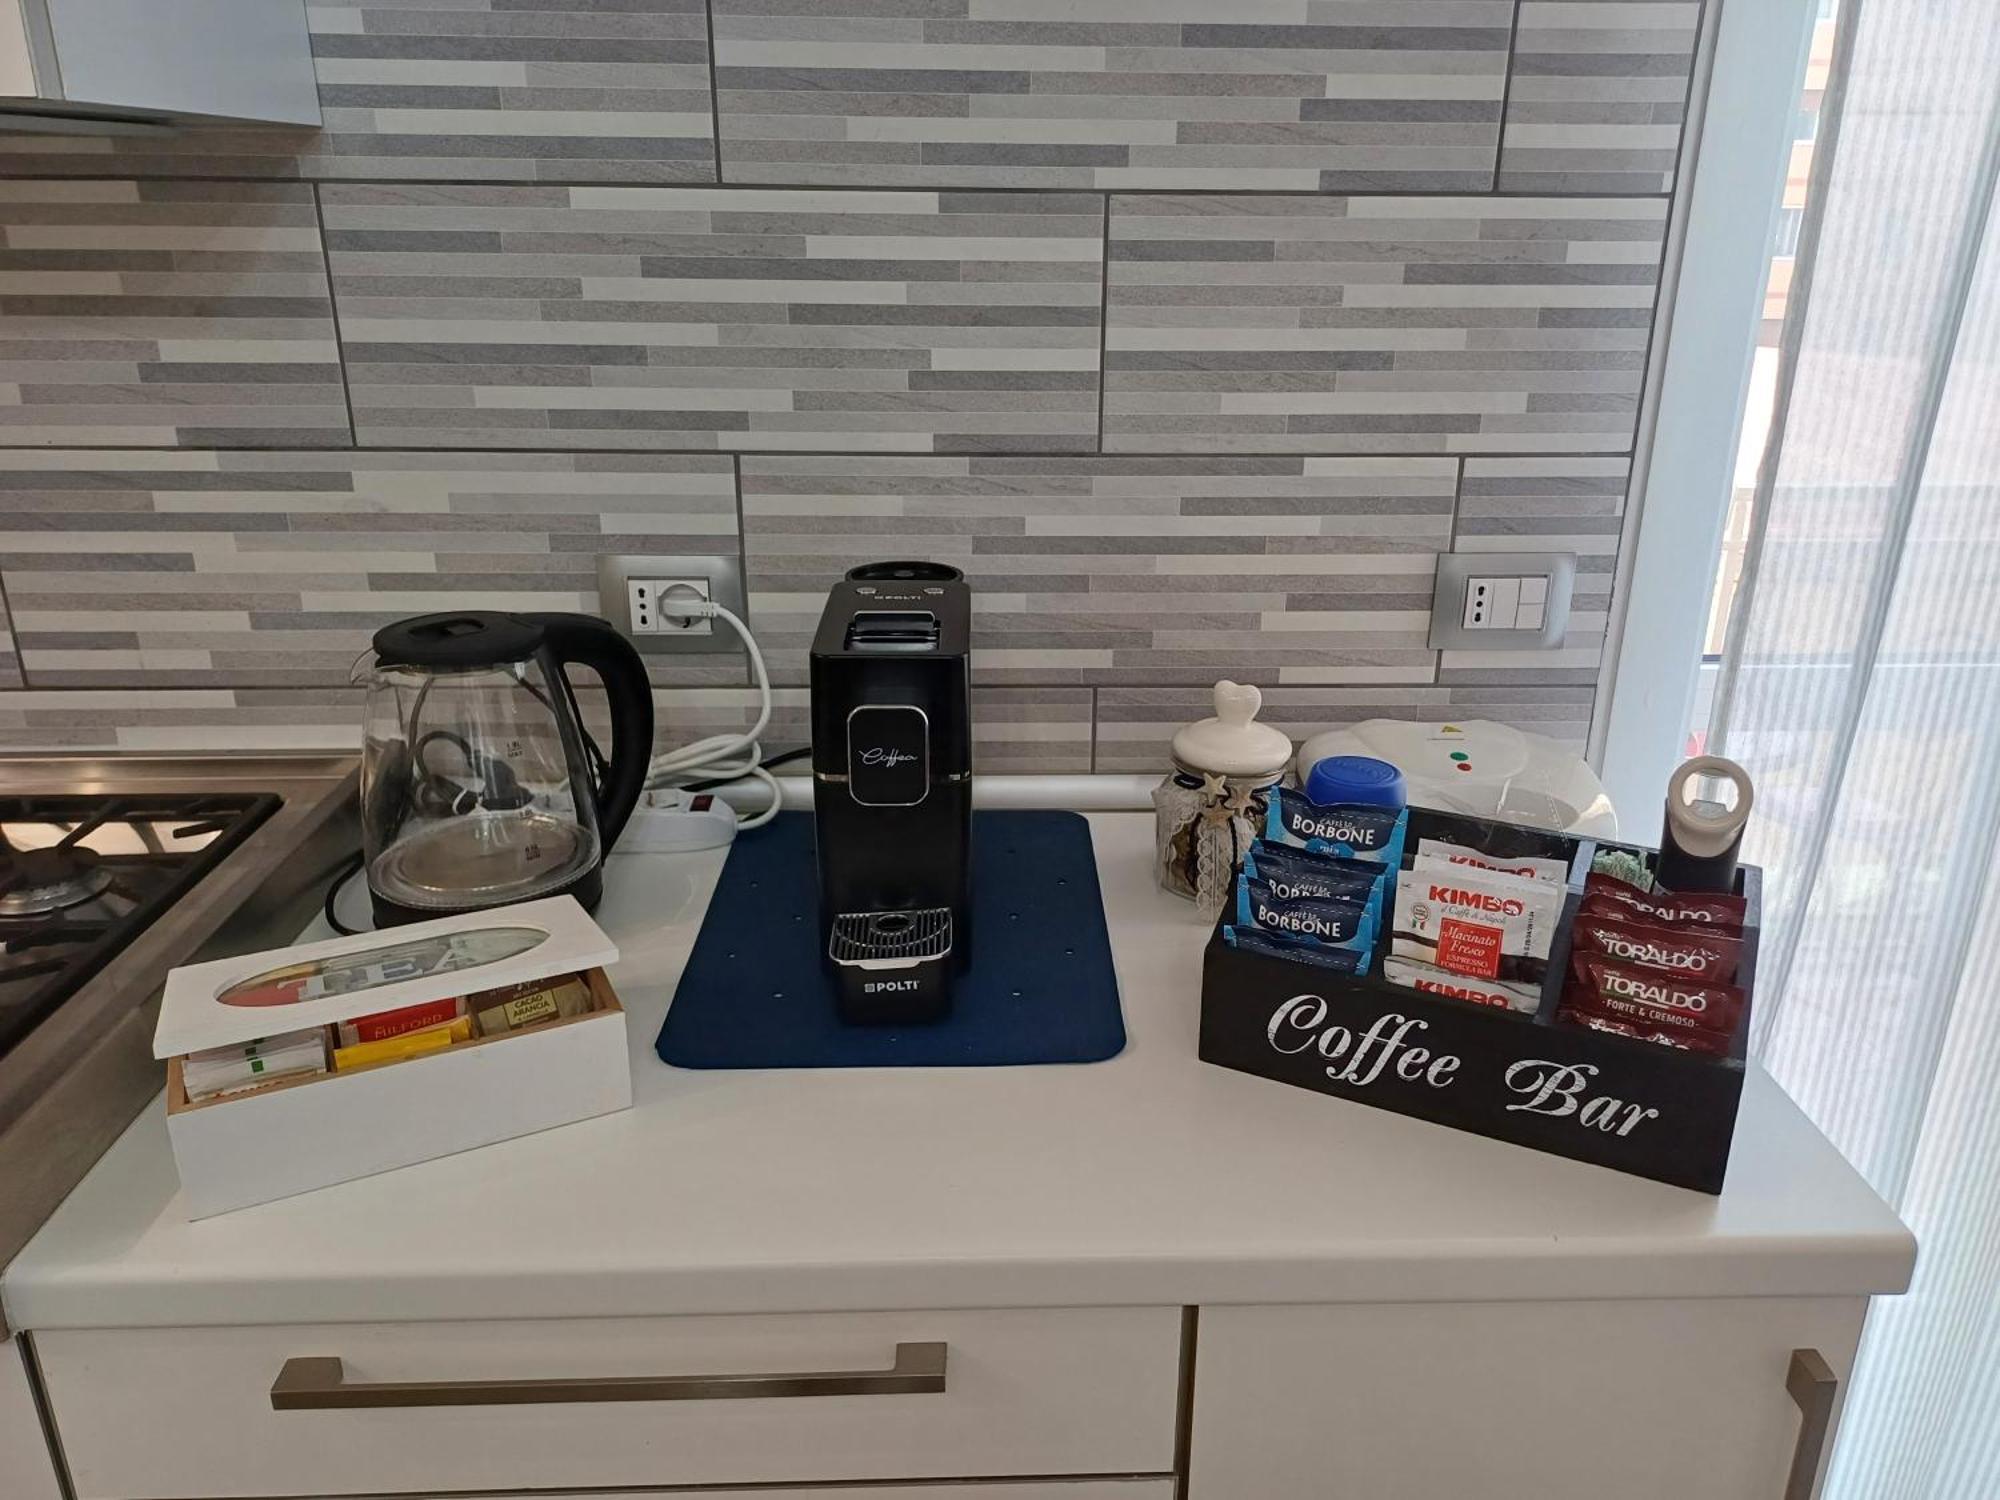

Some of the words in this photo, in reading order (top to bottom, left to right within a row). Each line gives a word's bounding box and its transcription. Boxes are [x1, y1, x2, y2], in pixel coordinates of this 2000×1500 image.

[1292, 814, 1376, 846] BORBONE
[1429, 885, 1524, 917] KIMBO
[1258, 904, 1341, 937] BORBONE
[1443, 926, 1496, 947] Macinato
[1450, 940, 1486, 957] Fresco
[1446, 954, 1489, 967] ESPRESSO
[1603, 938, 1707, 971] TORALDO
[876, 981, 918, 992] POLTI
[1603, 975, 1707, 1012] TORALDO
[513, 1001, 551, 1018] ARANCIA
[514, 994, 544, 1009] CACAO
[1606, 999, 1635, 1014] FORTE
[1638, 1007, 1646, 1017] &
[1649, 1010, 1695, 1028] CREMOSO
[1267, 994, 1462, 1088] Coffee
[1504, 1059, 1660, 1138] Bar
